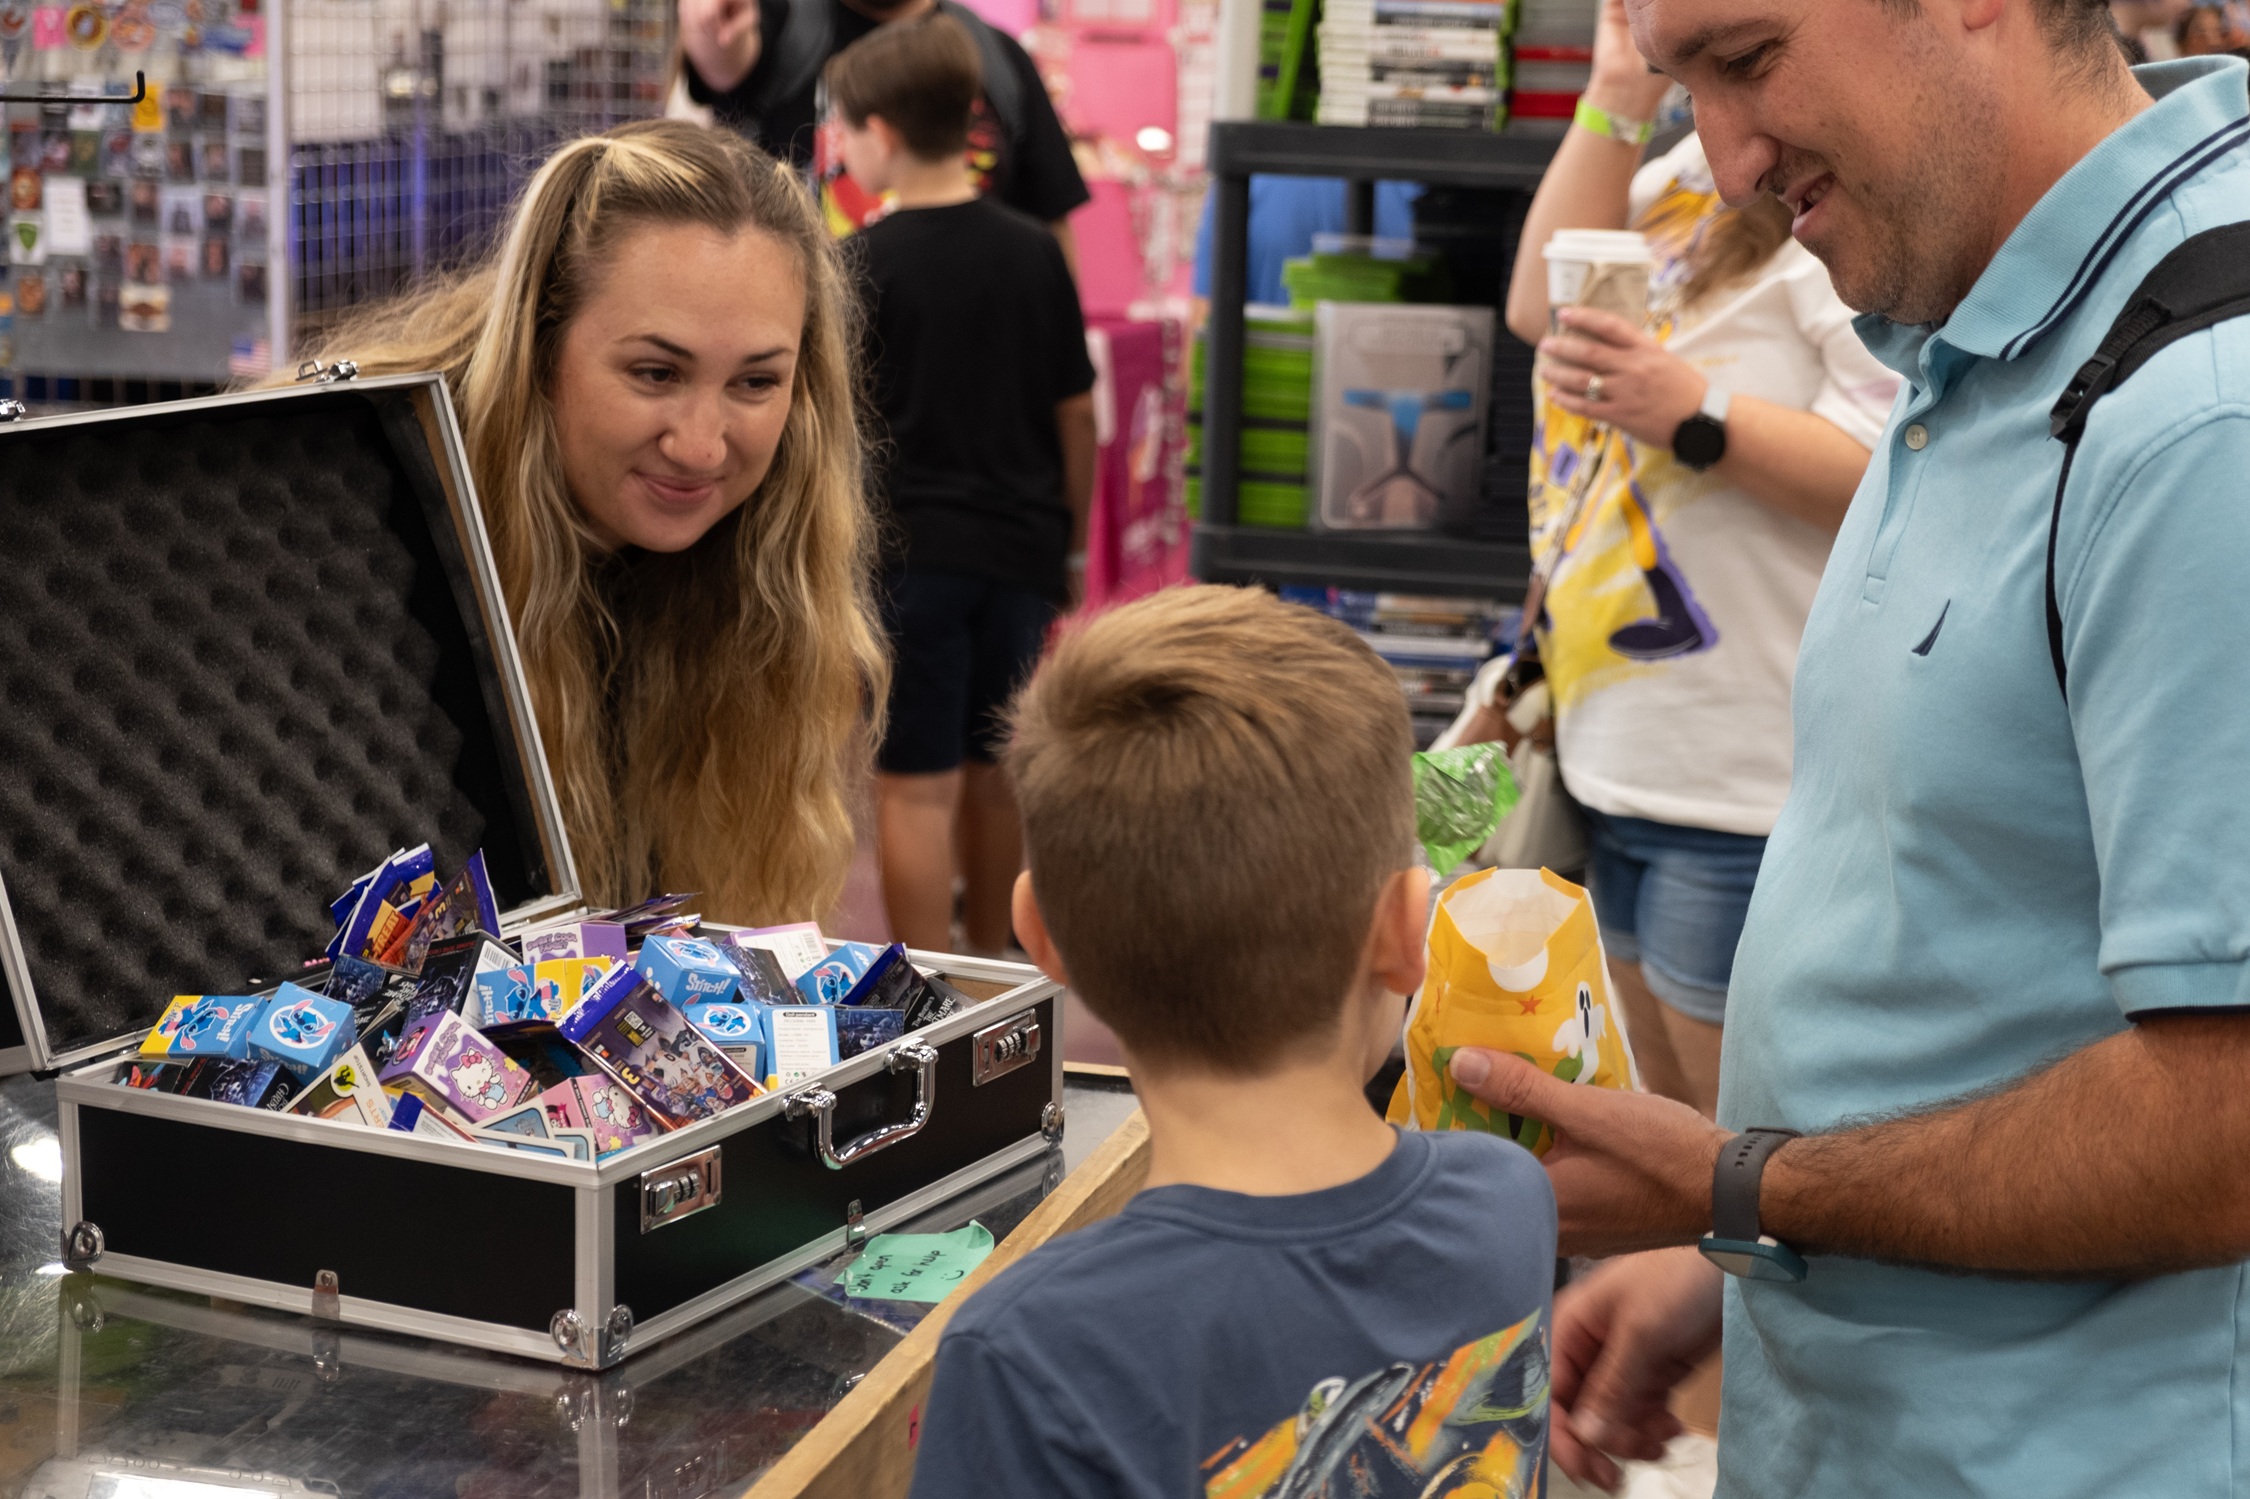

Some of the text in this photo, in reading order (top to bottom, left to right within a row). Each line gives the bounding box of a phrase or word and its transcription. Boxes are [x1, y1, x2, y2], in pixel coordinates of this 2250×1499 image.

[685, 972, 732, 995] Stitch!
[215, 1002, 255, 1043] Stitch!
[353, 1054, 371, 1088] SHORTSTOP
[366, 1098, 385, 1128] ERTS
[869, 1254, 893, 1271] open
[890, 1281, 911, 1294] ask
